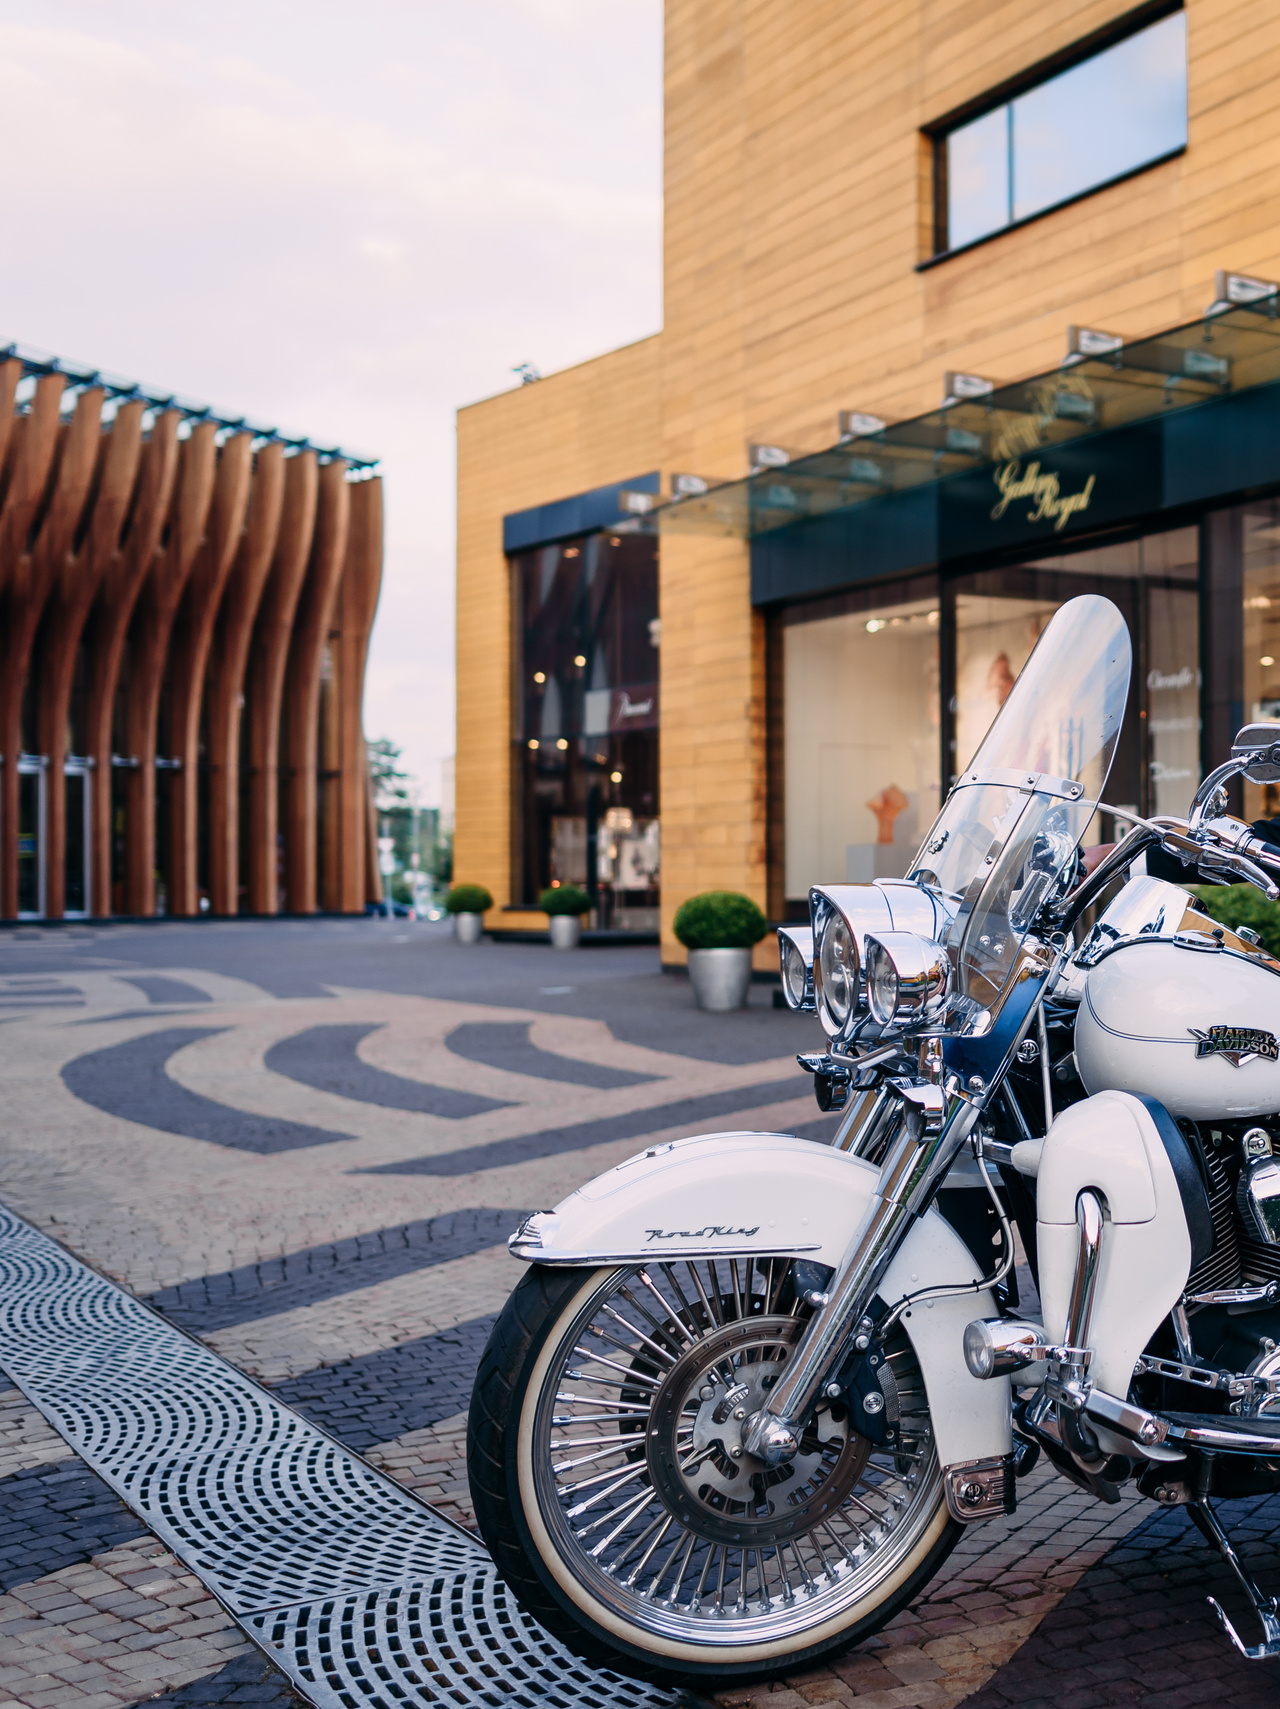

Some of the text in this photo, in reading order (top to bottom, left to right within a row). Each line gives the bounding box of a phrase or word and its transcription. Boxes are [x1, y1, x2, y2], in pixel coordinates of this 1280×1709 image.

[1027, 474, 1096, 532] Royal
[1210, 1026, 1276, 1045] HARLEY-
[1200, 1039, 1279, 1058] DAVIDSON
[645, 1226, 760, 1242] Road King
